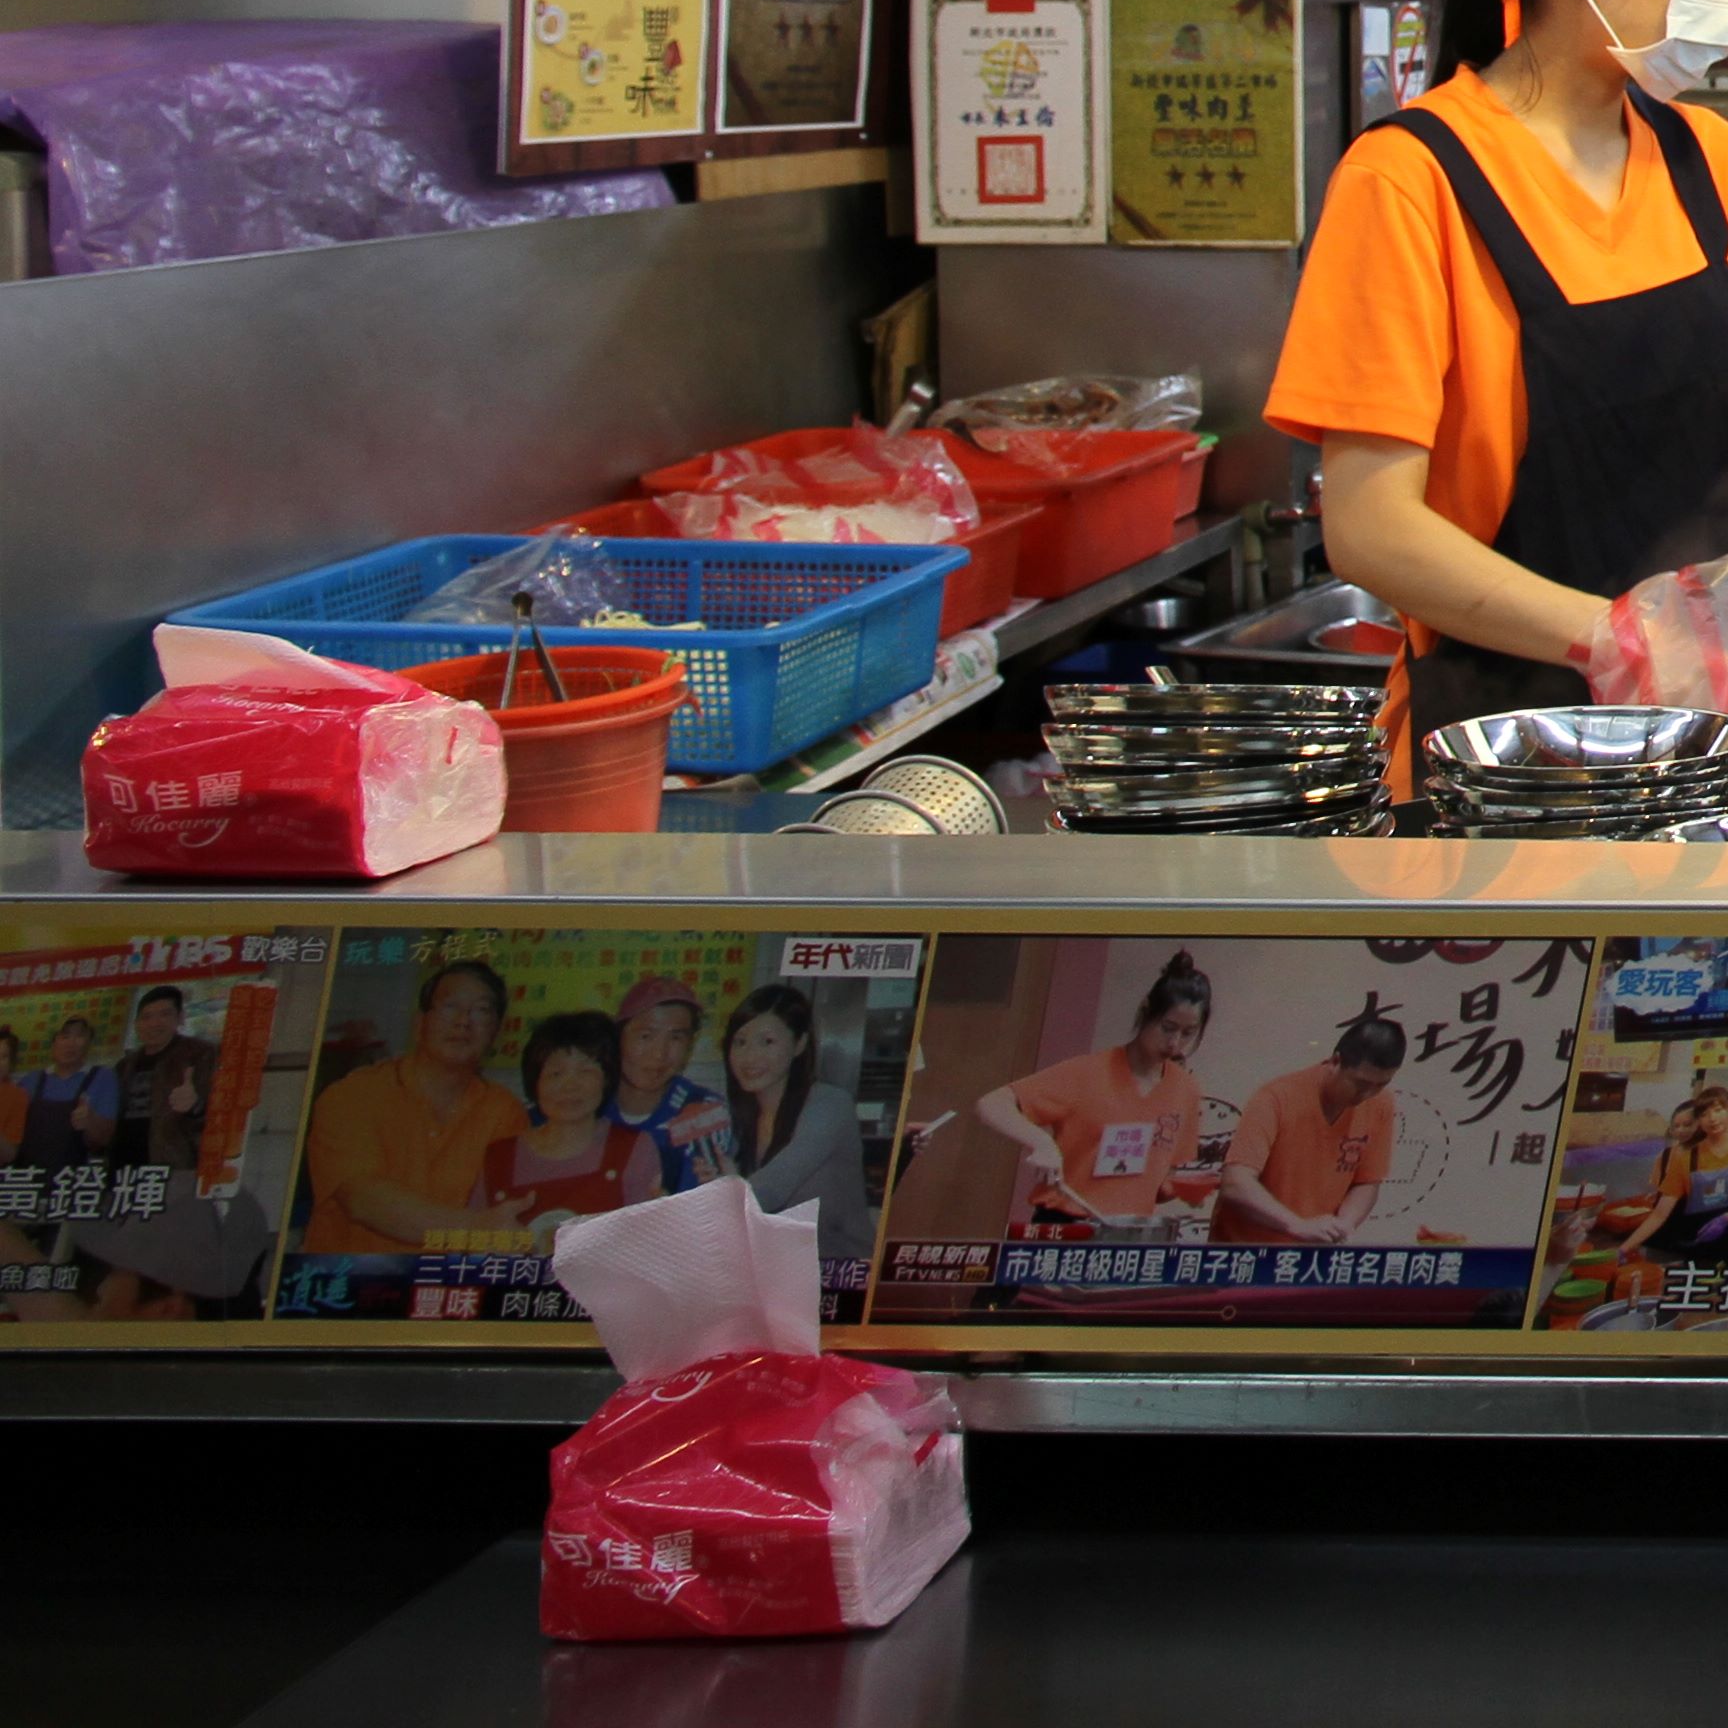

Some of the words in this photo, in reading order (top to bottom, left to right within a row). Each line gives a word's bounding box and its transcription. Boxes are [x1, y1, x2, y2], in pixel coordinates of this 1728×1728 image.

[103, 770, 243, 813] 可佳麗
[128, 814, 230, 849] Kocarry
[240, 934, 327, 965] 歡樂台
[788, 940, 919, 973] 年代新聞
[1615, 966, 1705, 1000] 愛玩客
[0, 1165, 170, 1219] 黃鐙輝
[1022, 1222, 1064, 1242] 新北
[893, 1245, 992, 1265] 民視新聞
[1275, 1249, 1464, 1286] 客人指名買肉羹
[414, 1288, 480, 1320] 豐味
[549, 1528, 695, 1574] 可佳麗
